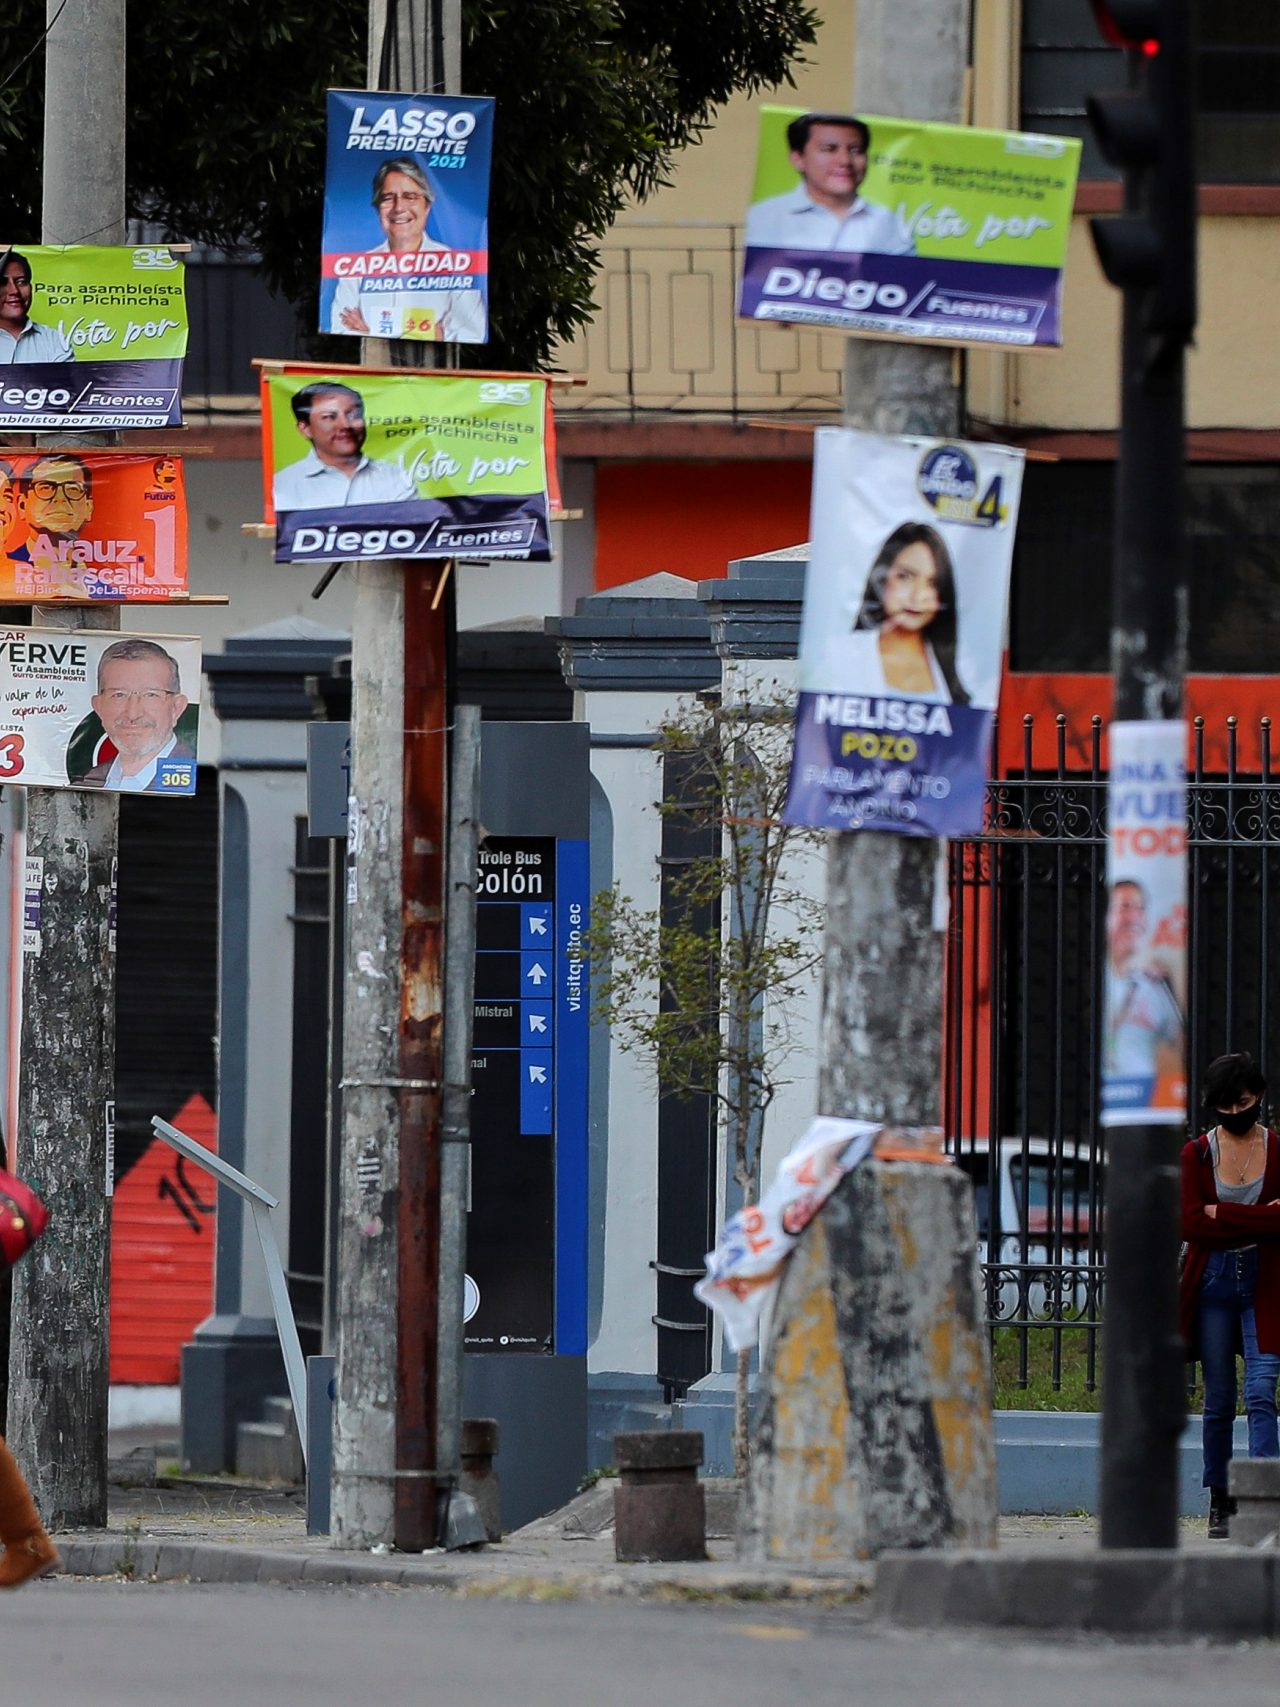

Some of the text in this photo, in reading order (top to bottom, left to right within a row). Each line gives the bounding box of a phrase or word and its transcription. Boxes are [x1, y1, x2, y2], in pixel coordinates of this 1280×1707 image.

[349, 107, 476, 140] LASSO
[346, 135, 468, 155] PRESIDENTE
[428, 155, 467, 169] 2021
[896, 201, 1054, 248] Vota por
[133, 248, 177, 266] 35
[334, 253, 471, 275] CAPACIDAD
[35, 283, 182, 295] Para asambleísta
[364, 276, 473, 291] PARA CAMBIAR
[49, 295, 169, 307] por Pichincha
[762, 266, 1028, 323] Diego Fuentes
[58, 317, 180, 351] Vota por
[88, 393, 164, 407] Fuentes
[480, 382, 531, 403] 35
[61, 416, 88, 425] por
[91, 415, 164, 426] Pichincha
[369, 414, 535, 433] Para asambleísta
[385, 425, 518, 444] por Pichincha
[400, 448, 529, 487] Vota por
[144, 492, 176, 500] Futuro
[976, 474, 1002, 528] 4
[29, 534, 138, 563] Arauz
[143, 505, 186, 586] 1
[291, 525, 524, 555] Diego Fuentes
[14, 562, 145, 585] Rabascall
[11, 664, 86, 676] Tu Asambleísta
[5, 689, 31, 702] valor
[35, 686, 48, 699] de
[51, 686, 64, 699] la
[12, 703, 67, 721] experiencia
[814, 694, 954, 738] MELISSA
[0, 724, 24, 732] LISTA
[841, 731, 918, 763] POZO
[162, 773, 191, 786] 30S
[478, 851, 542, 865] Trole Bus
[475, 867, 542, 894] Colón
[566, 903, 584, 1012] visitquito.ec
[475, 1006, 513, 1017] Mistral
